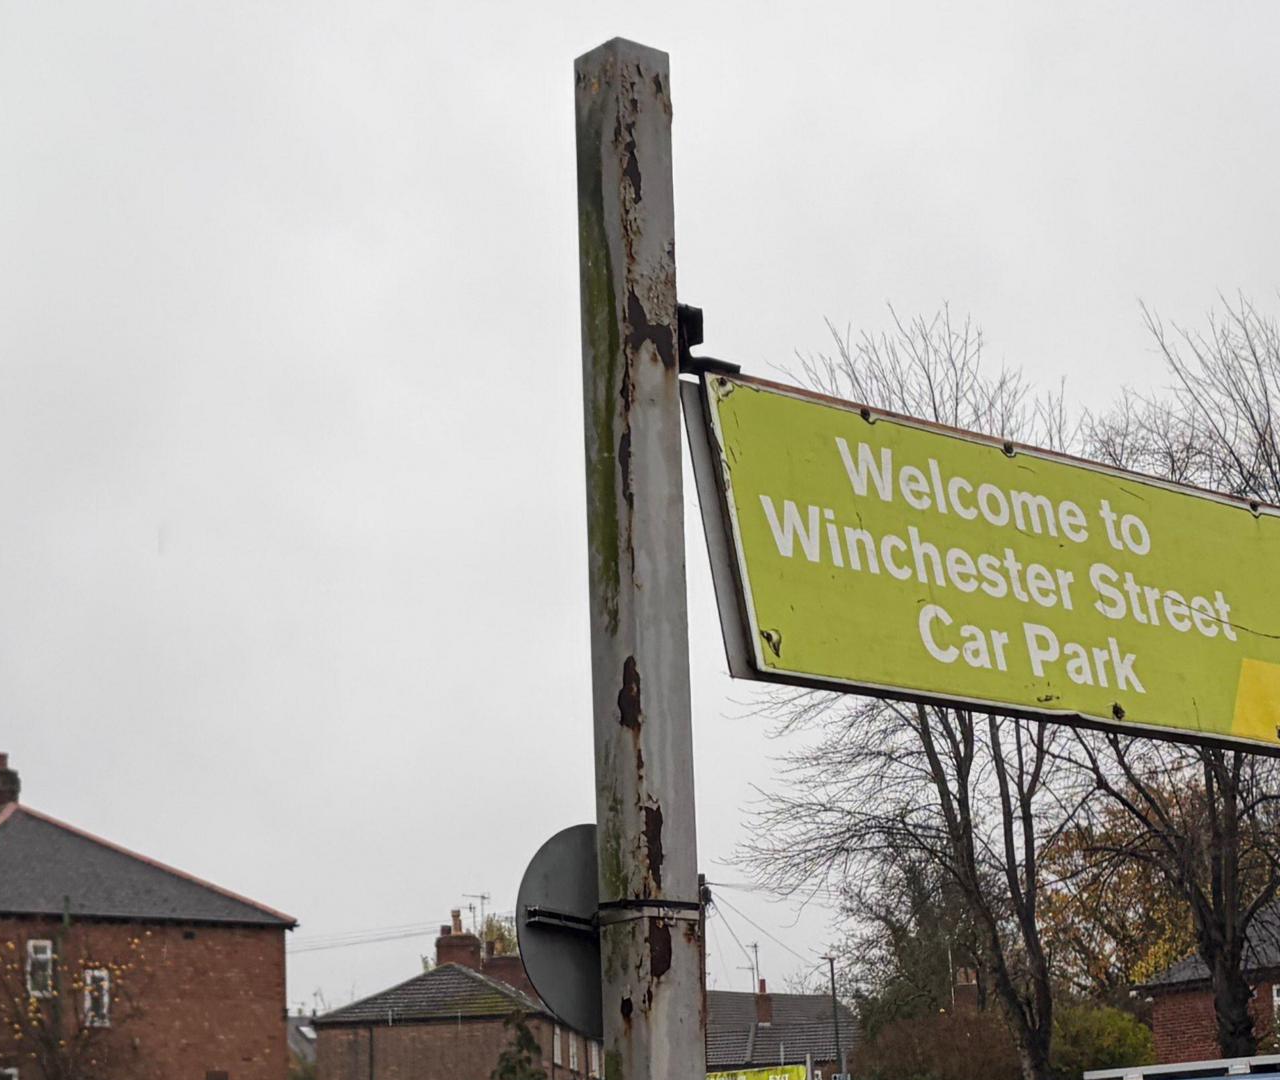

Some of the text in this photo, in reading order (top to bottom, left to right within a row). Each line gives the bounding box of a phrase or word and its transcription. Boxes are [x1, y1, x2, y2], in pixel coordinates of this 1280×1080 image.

[834, 436, 1151, 555] Welcome to
[759, 495, 1238, 642] Winchester Street
[919, 603, 1147, 694] Car Park
